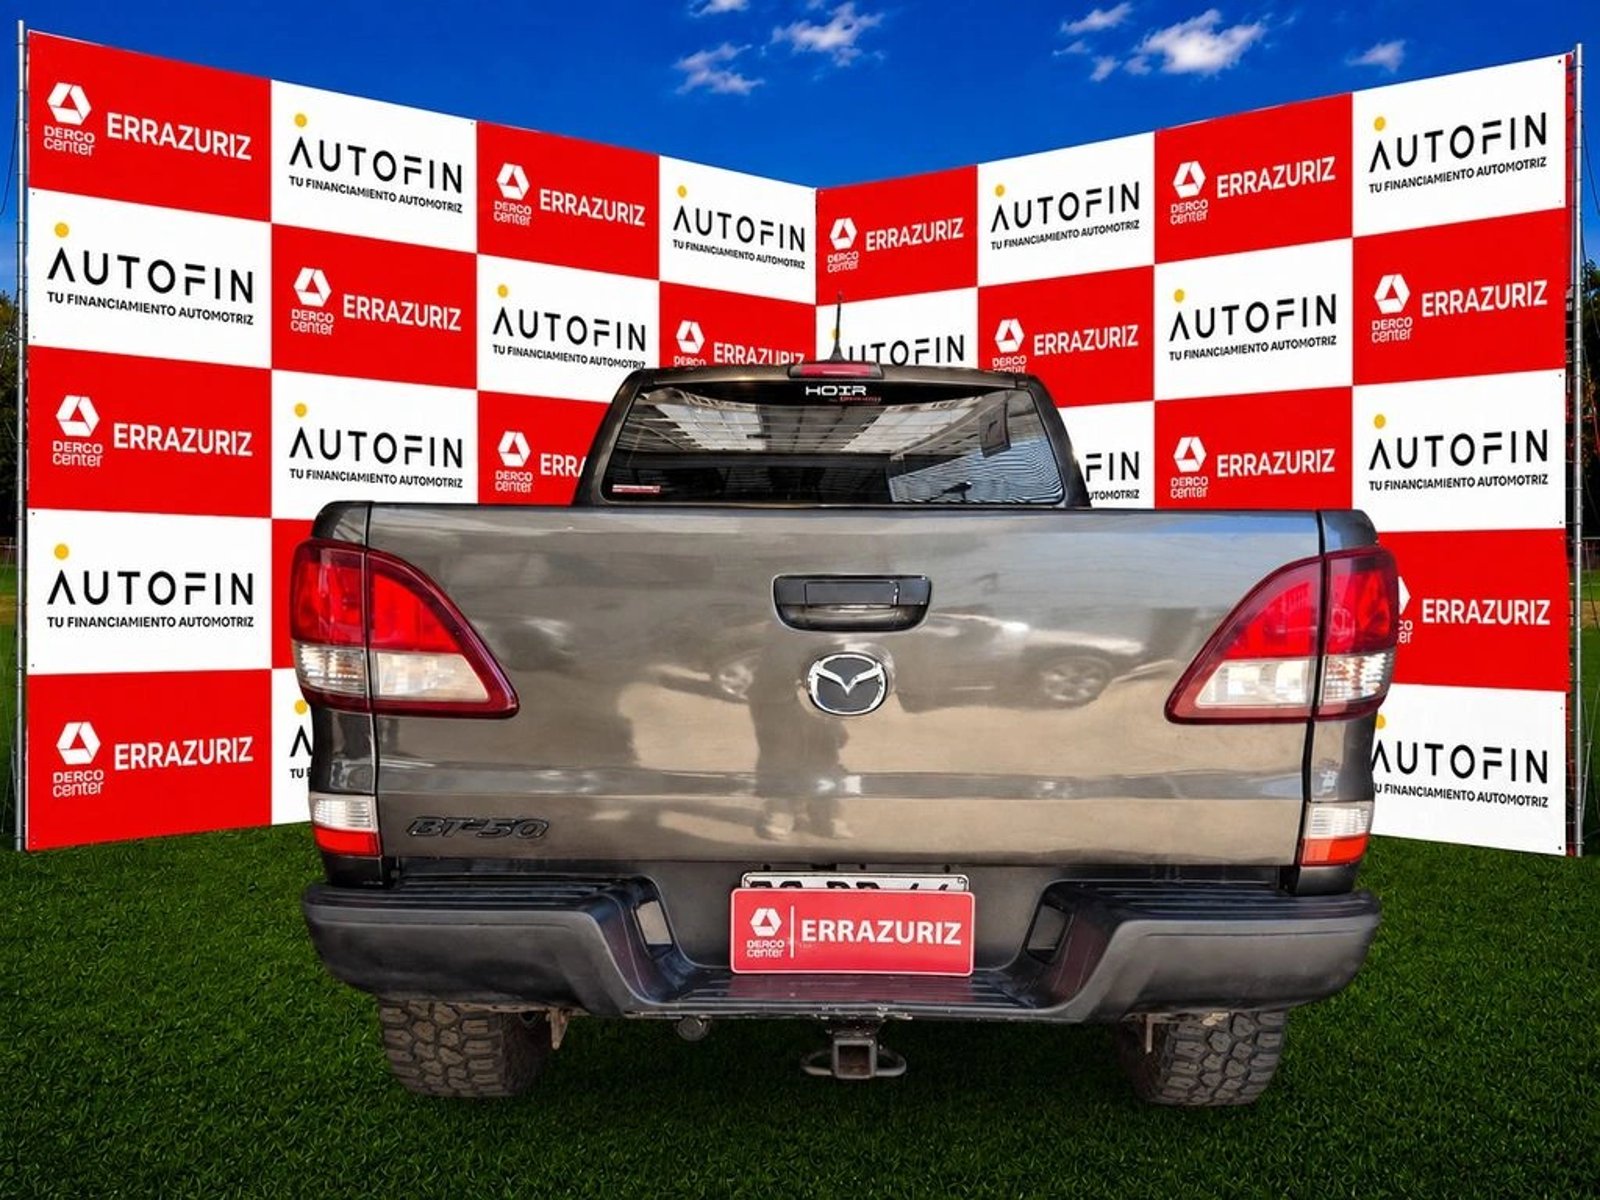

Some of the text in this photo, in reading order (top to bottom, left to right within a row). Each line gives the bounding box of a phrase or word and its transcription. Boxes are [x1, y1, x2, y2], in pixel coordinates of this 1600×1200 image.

[44, 137, 93, 155] center
[45, 126, 95, 143] DERCO
[108, 113, 251, 160] ERRAZURIZ
[1369, 112, 1546, 172] AUTOFIN
[289, 137, 461, 193] AUTOFIN
[1369, 157, 1546, 193] TU FINANCIAMIENTO AUTOMOTRIZ
[1217, 156, 1335, 198] ERRAZURIZ
[289, 176, 462, 213] TU FINANCIAMIENTO AUTOMOTRIZ
[1171, 199, 1208, 213] DERCO
[494, 211, 530, 225] center
[495, 201, 531, 215] DERCO
[540, 189, 645, 226] ERRAZURIZ
[991, 182, 1139, 232] AUTOFIN
[1171, 208, 1207, 224] center
[673, 206, 805, 252] AUTOFIN
[866, 218, 963, 251] ERRAZURIZ
[992, 220, 1139, 249] TU FINANCIAMIENTO AUTOMOTRIZ
[673, 239, 805, 269] TU FINANCIAMIENTO AUTOMOTRIZ
[828, 251, 858, 263] DERCO
[48, 248, 252, 303] AUTOFIN
[828, 260, 858, 272] center
[47, 292, 253, 325] TU FINANCIAMIENTO AUTOMOTRIZ
[1422, 280, 1547, 317] ERRAZURIZ
[292, 309, 334, 323] DERCO
[344, 294, 461, 331] ERRAZURIZ
[1170, 294, 1336, 341] AUTOFIN
[1372, 317, 1412, 330] DERCO
[291, 320, 333, 334] center
[493, 307, 645, 351] AUTOFIN
[1372, 328, 1411, 342] center
[849, 335, 964, 366] UTOFIN
[1033, 325, 1139, 356] ERRAZURIZ
[1170, 336, 1336, 360] TU FINANCIAMIENTO AUTOMOTRIZ
[493, 345, 505, 354] TU
[508, 346, 587, 364] FINANCIAMIENTO
[992, 355, 1027, 367] DERCO
[805, 385, 867, 396] HOIR
[53, 441, 102, 454] DERCO
[114, 423, 252, 456] ERRAZURIZ
[290, 427, 462, 468] AUTOFIN
[1369, 429, 1547, 470] AUTOFIN
[53, 453, 102, 466] center
[1217, 449, 1334, 477] ERRAZURIZ
[290, 469, 462, 488] TU FINANCIAMIENTO AUTOMOTRIZ
[495, 470, 533, 482] DERCO
[495, 481, 532, 493] center
[1171, 477, 1208, 487] DERCO
[1369, 474, 1548, 491] TU FINANCIAMIENTO AUTOMOTRIZ
[1089, 489, 1140, 500] UTOMOTRIZ
[1171, 487, 1207, 498] center
[47, 570, 253, 605] AUTOFIN
[47, 617, 253, 627] TU FINANCIAMIENTO AUTOMOTRIZ
[1423, 599, 1550, 625] ERRAZURIZ
[115, 736, 253, 770] ERRAZURIZ
[1371, 739, 1547, 784] AUTOFIN
[53, 770, 103, 783] DERCO
[290, 768, 304, 779] TU
[53, 781, 103, 797] center
[1385, 784, 1475, 801] FINANCIAMIENTO
[1477, 792, 1548, 808] AUTOMOTRIZ
[406, 816, 550, 839] BT-50
[801, 919, 962, 945] ERRAZURIZ
[746, 940, 785, 949] DERCO
[747, 949, 784, 959] center
